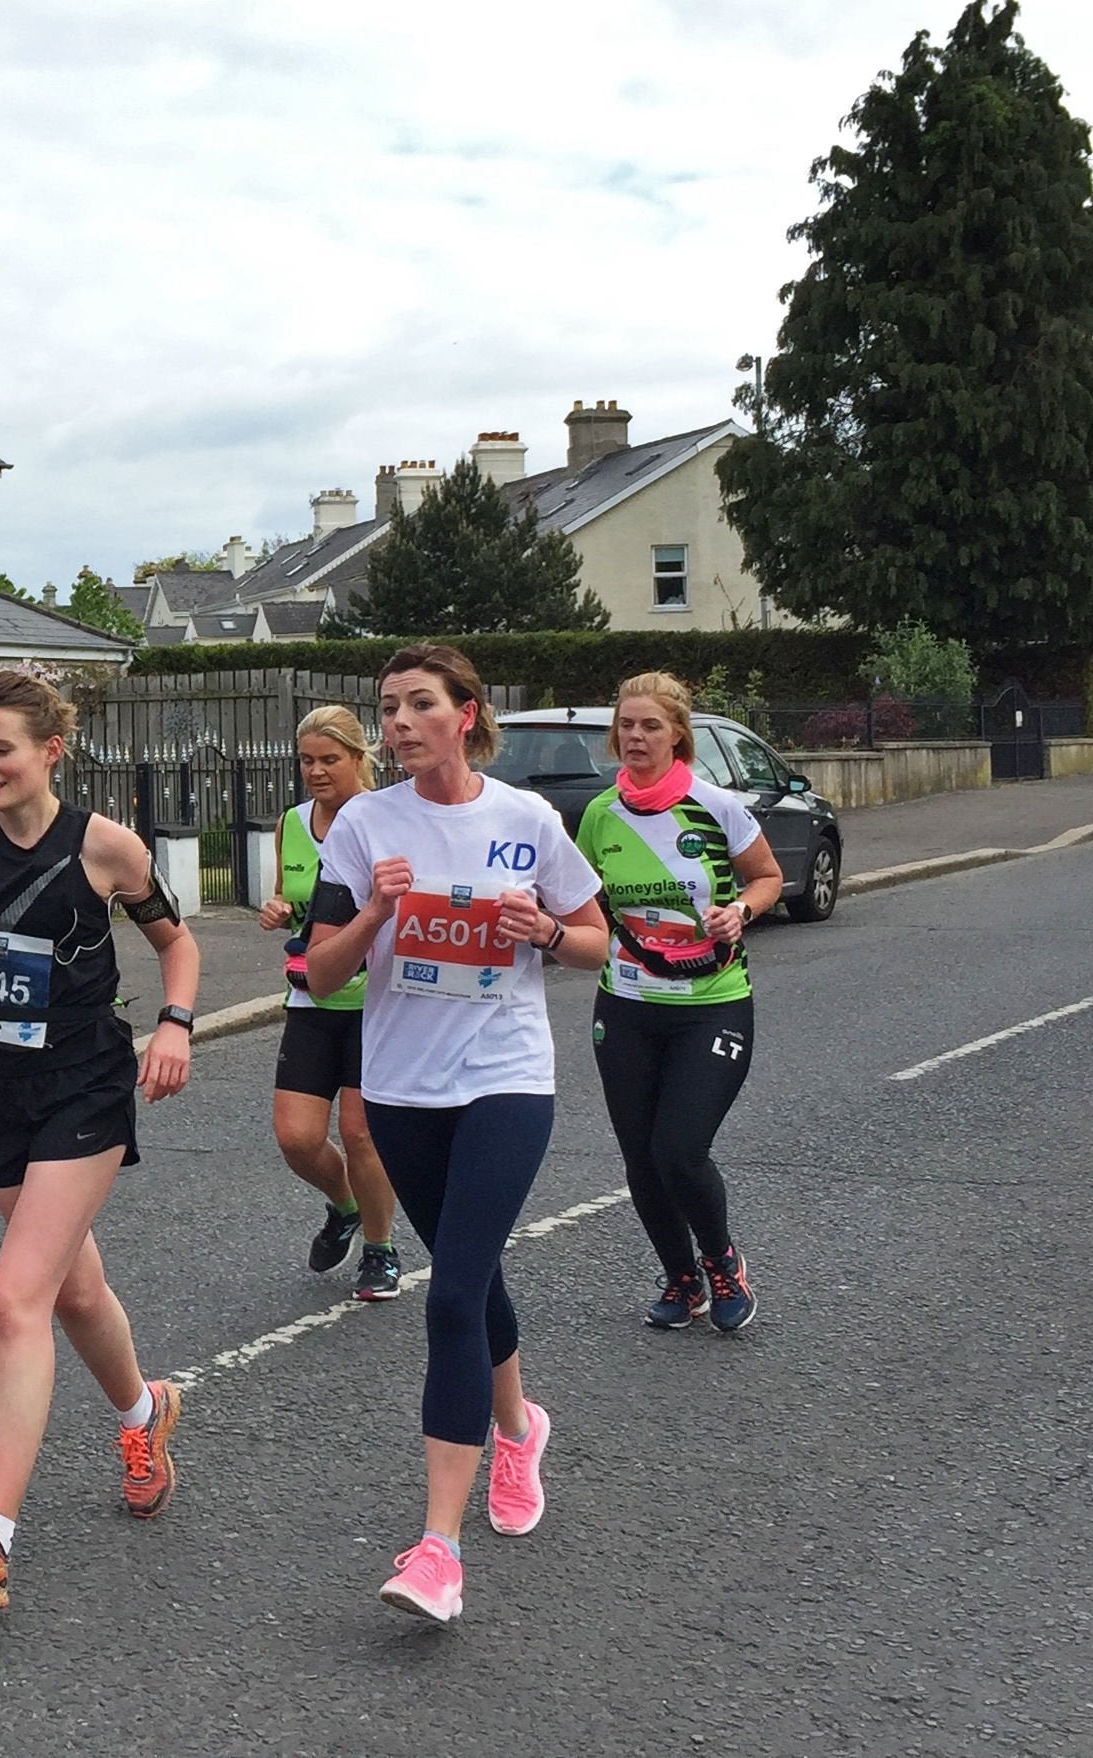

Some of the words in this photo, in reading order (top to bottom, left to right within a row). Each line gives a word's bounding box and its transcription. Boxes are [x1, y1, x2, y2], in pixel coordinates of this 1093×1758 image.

[486, 840, 537, 871] KD
[606, 879, 697, 896] Moneyglass
[711, 1036, 743, 1060] LT
